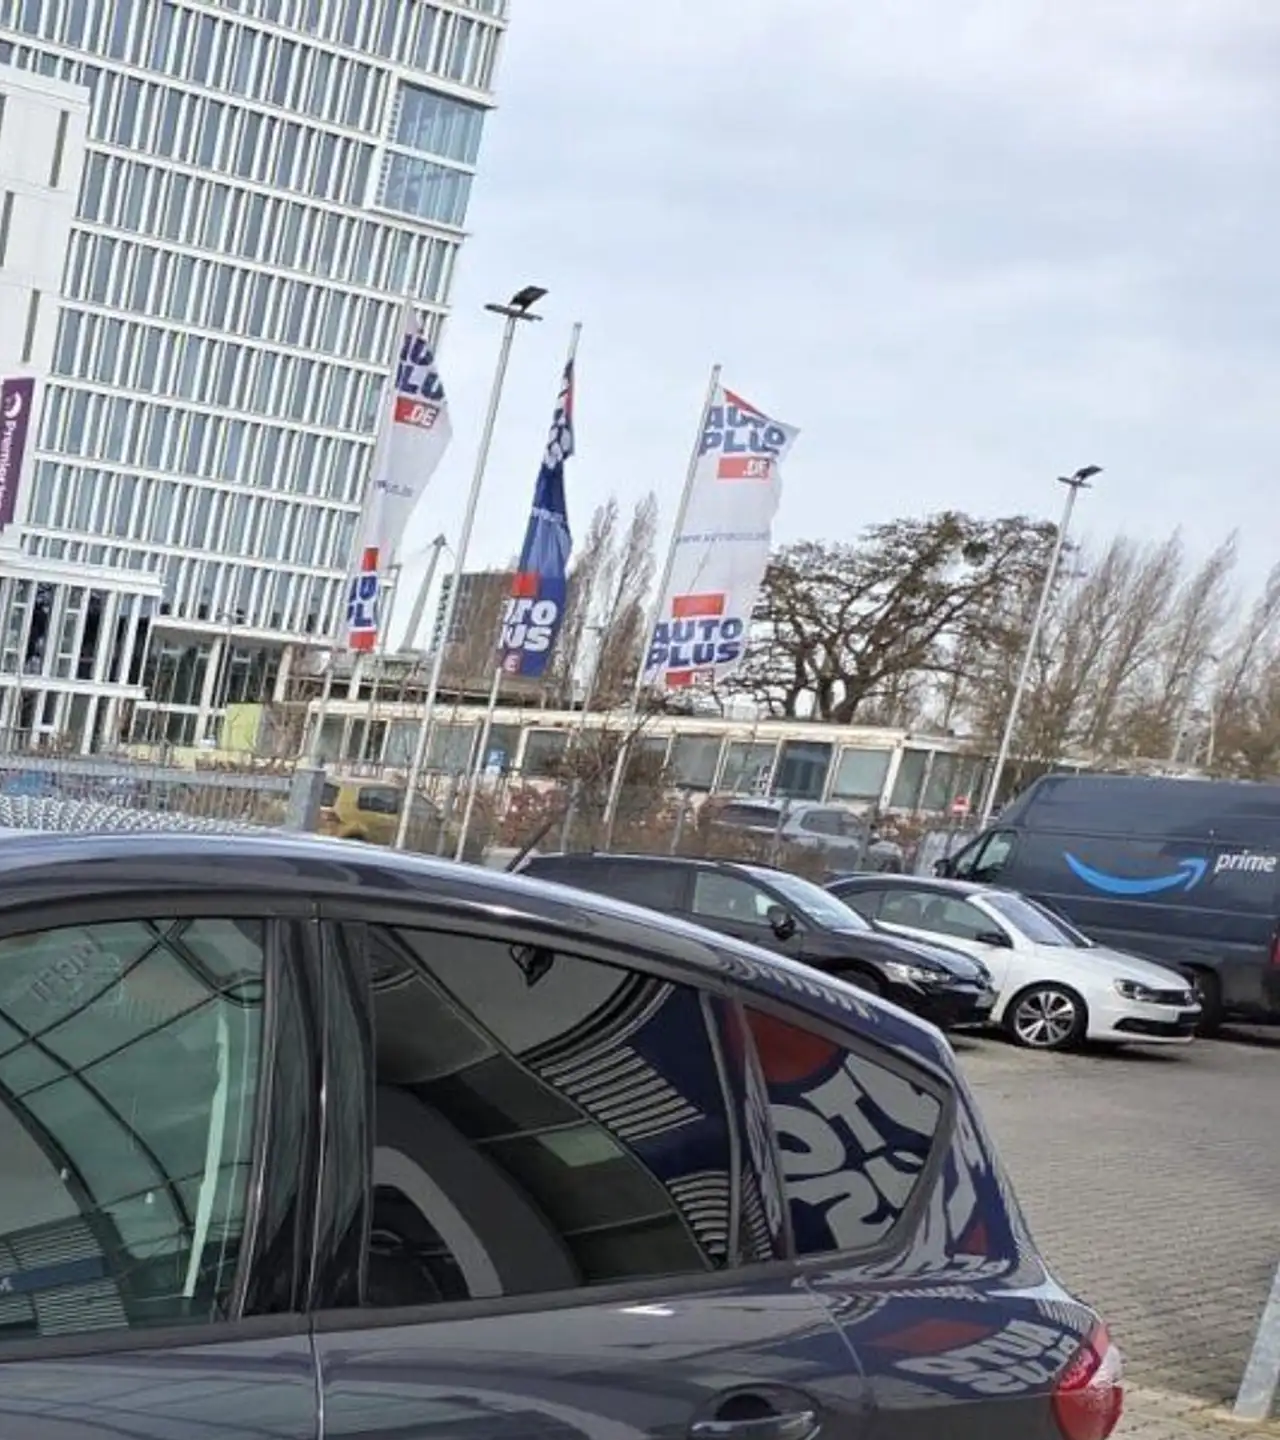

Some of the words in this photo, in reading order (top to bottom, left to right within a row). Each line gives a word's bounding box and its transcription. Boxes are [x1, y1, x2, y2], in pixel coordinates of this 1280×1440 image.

[652, 617, 744, 644] AUTO
[645, 642, 741, 671] PLUS
[1214, 849, 1277, 874] prime
